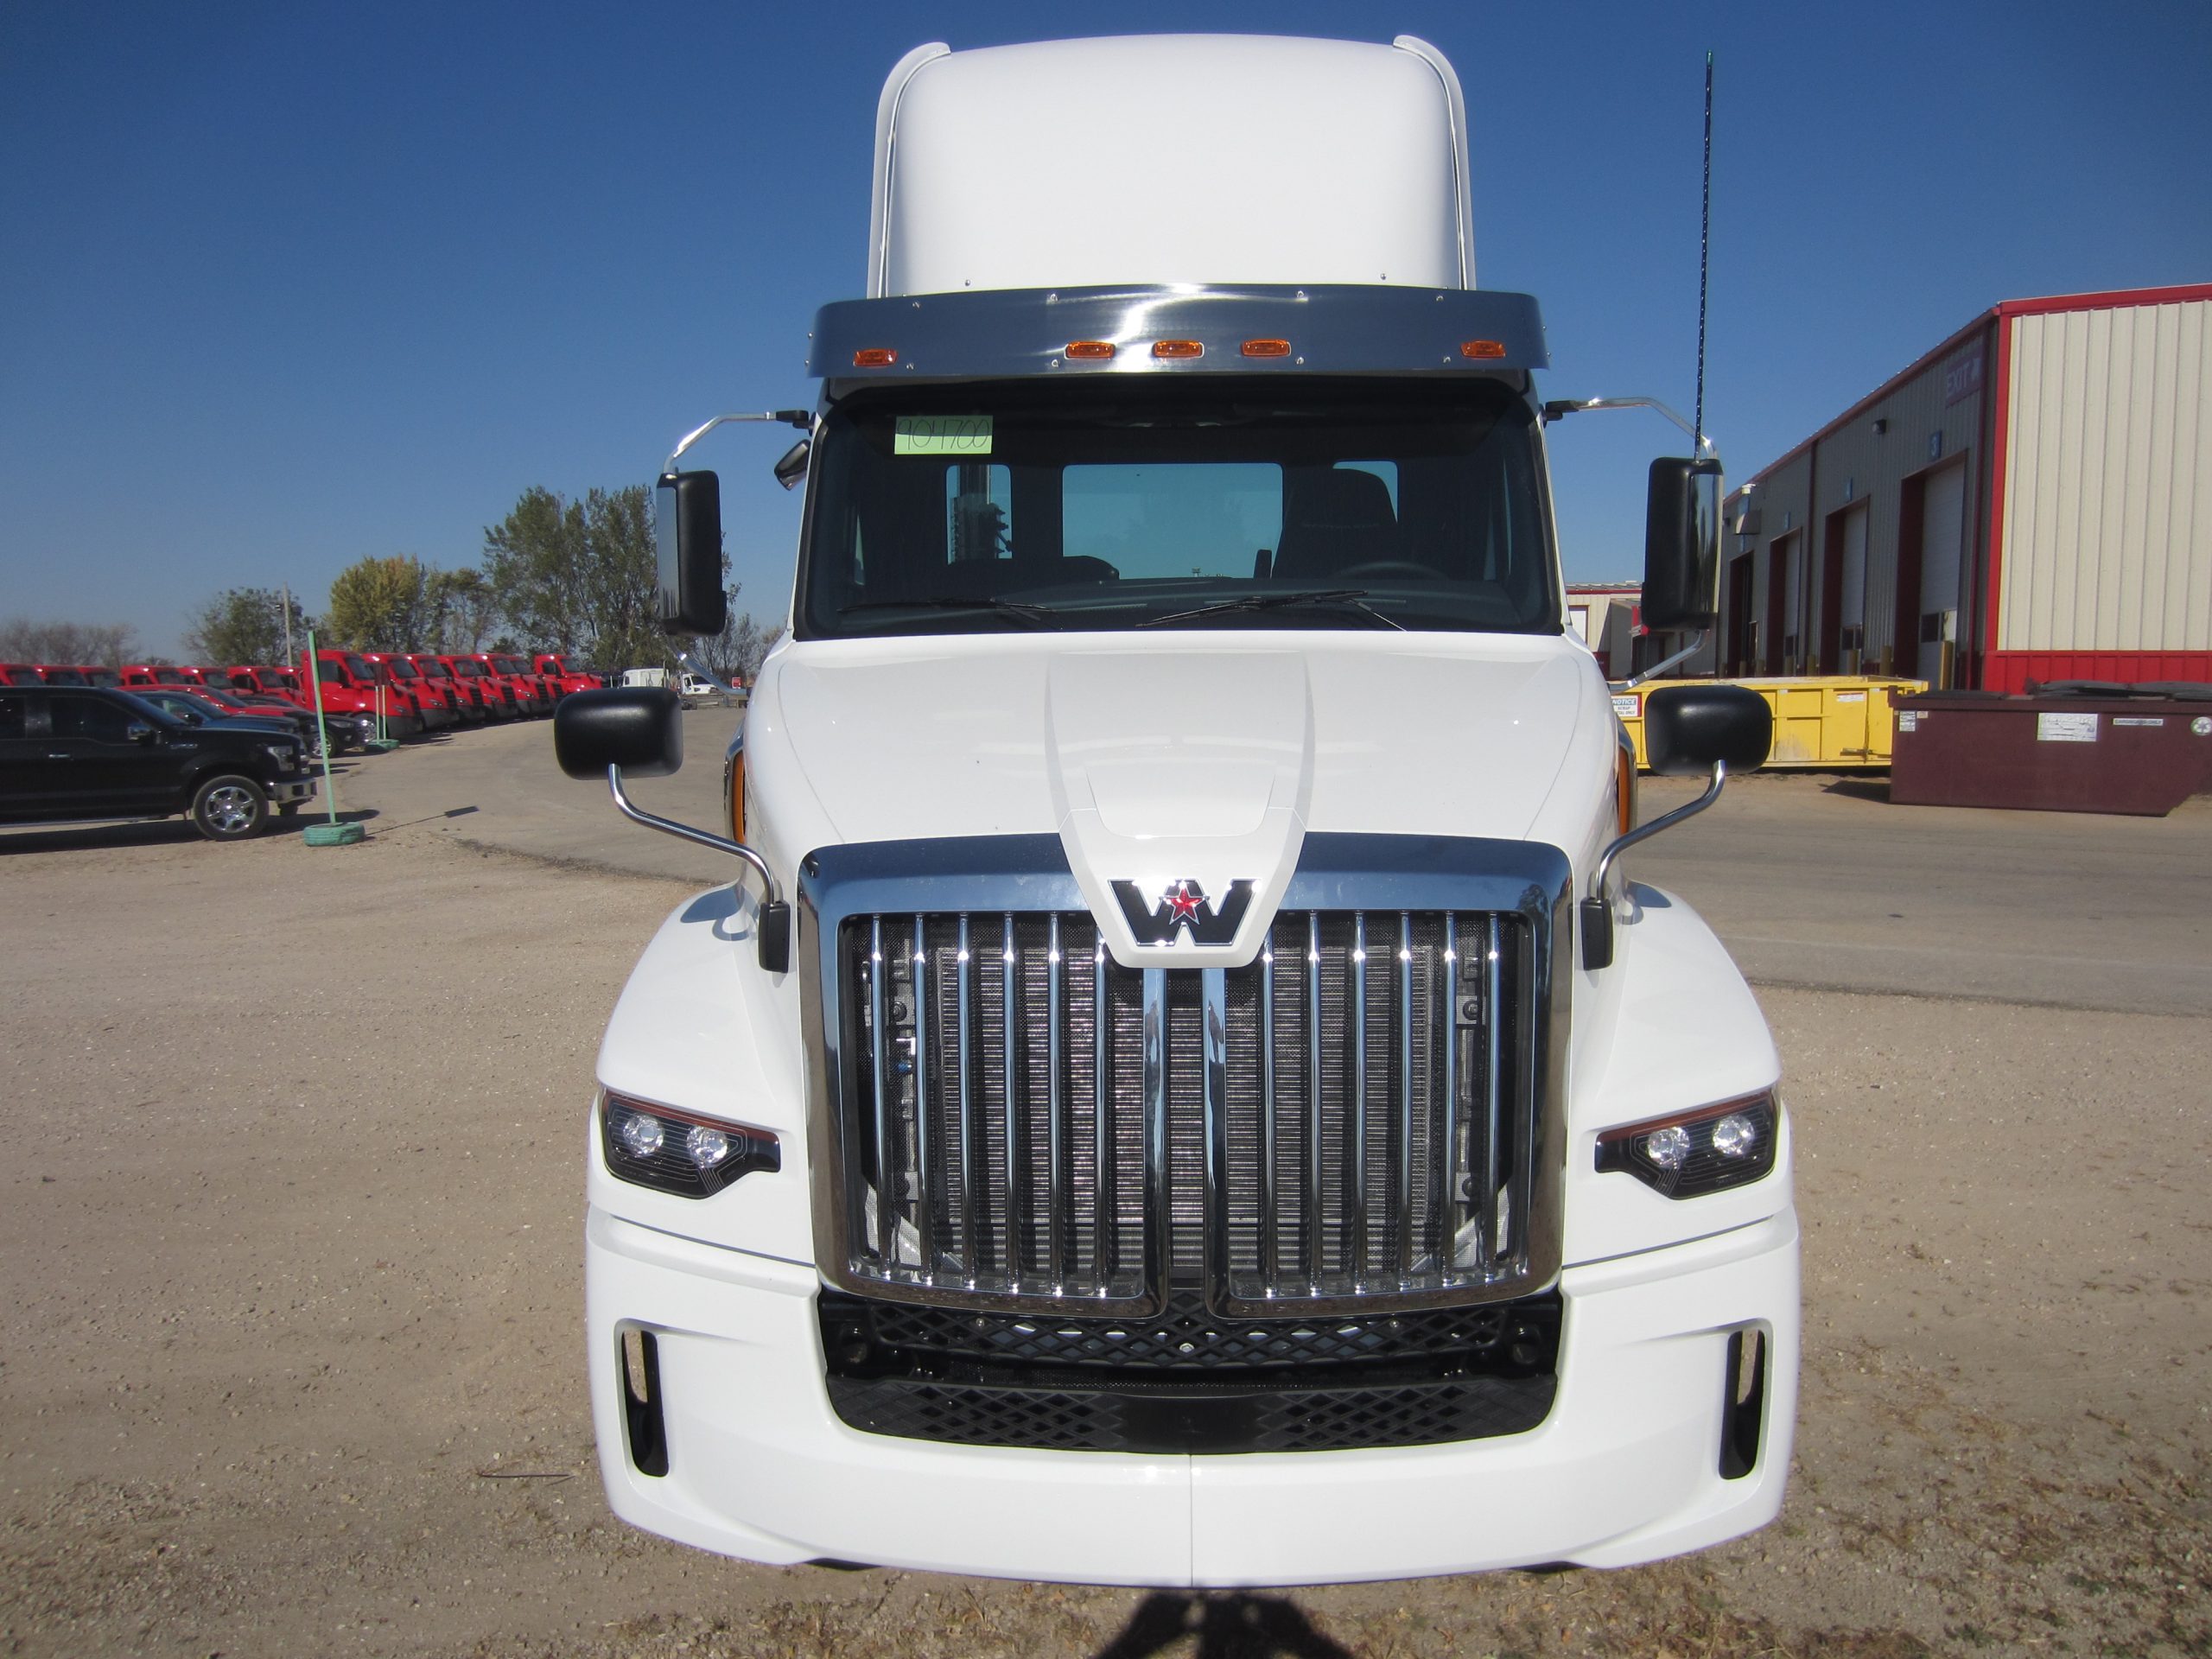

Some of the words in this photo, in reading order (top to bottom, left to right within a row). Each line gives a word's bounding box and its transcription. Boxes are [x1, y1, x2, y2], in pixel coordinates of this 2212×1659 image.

[1946, 361, 1969, 397] EXIT
[897, 418, 989, 450] 904700
[1108, 878, 1262, 947] W
